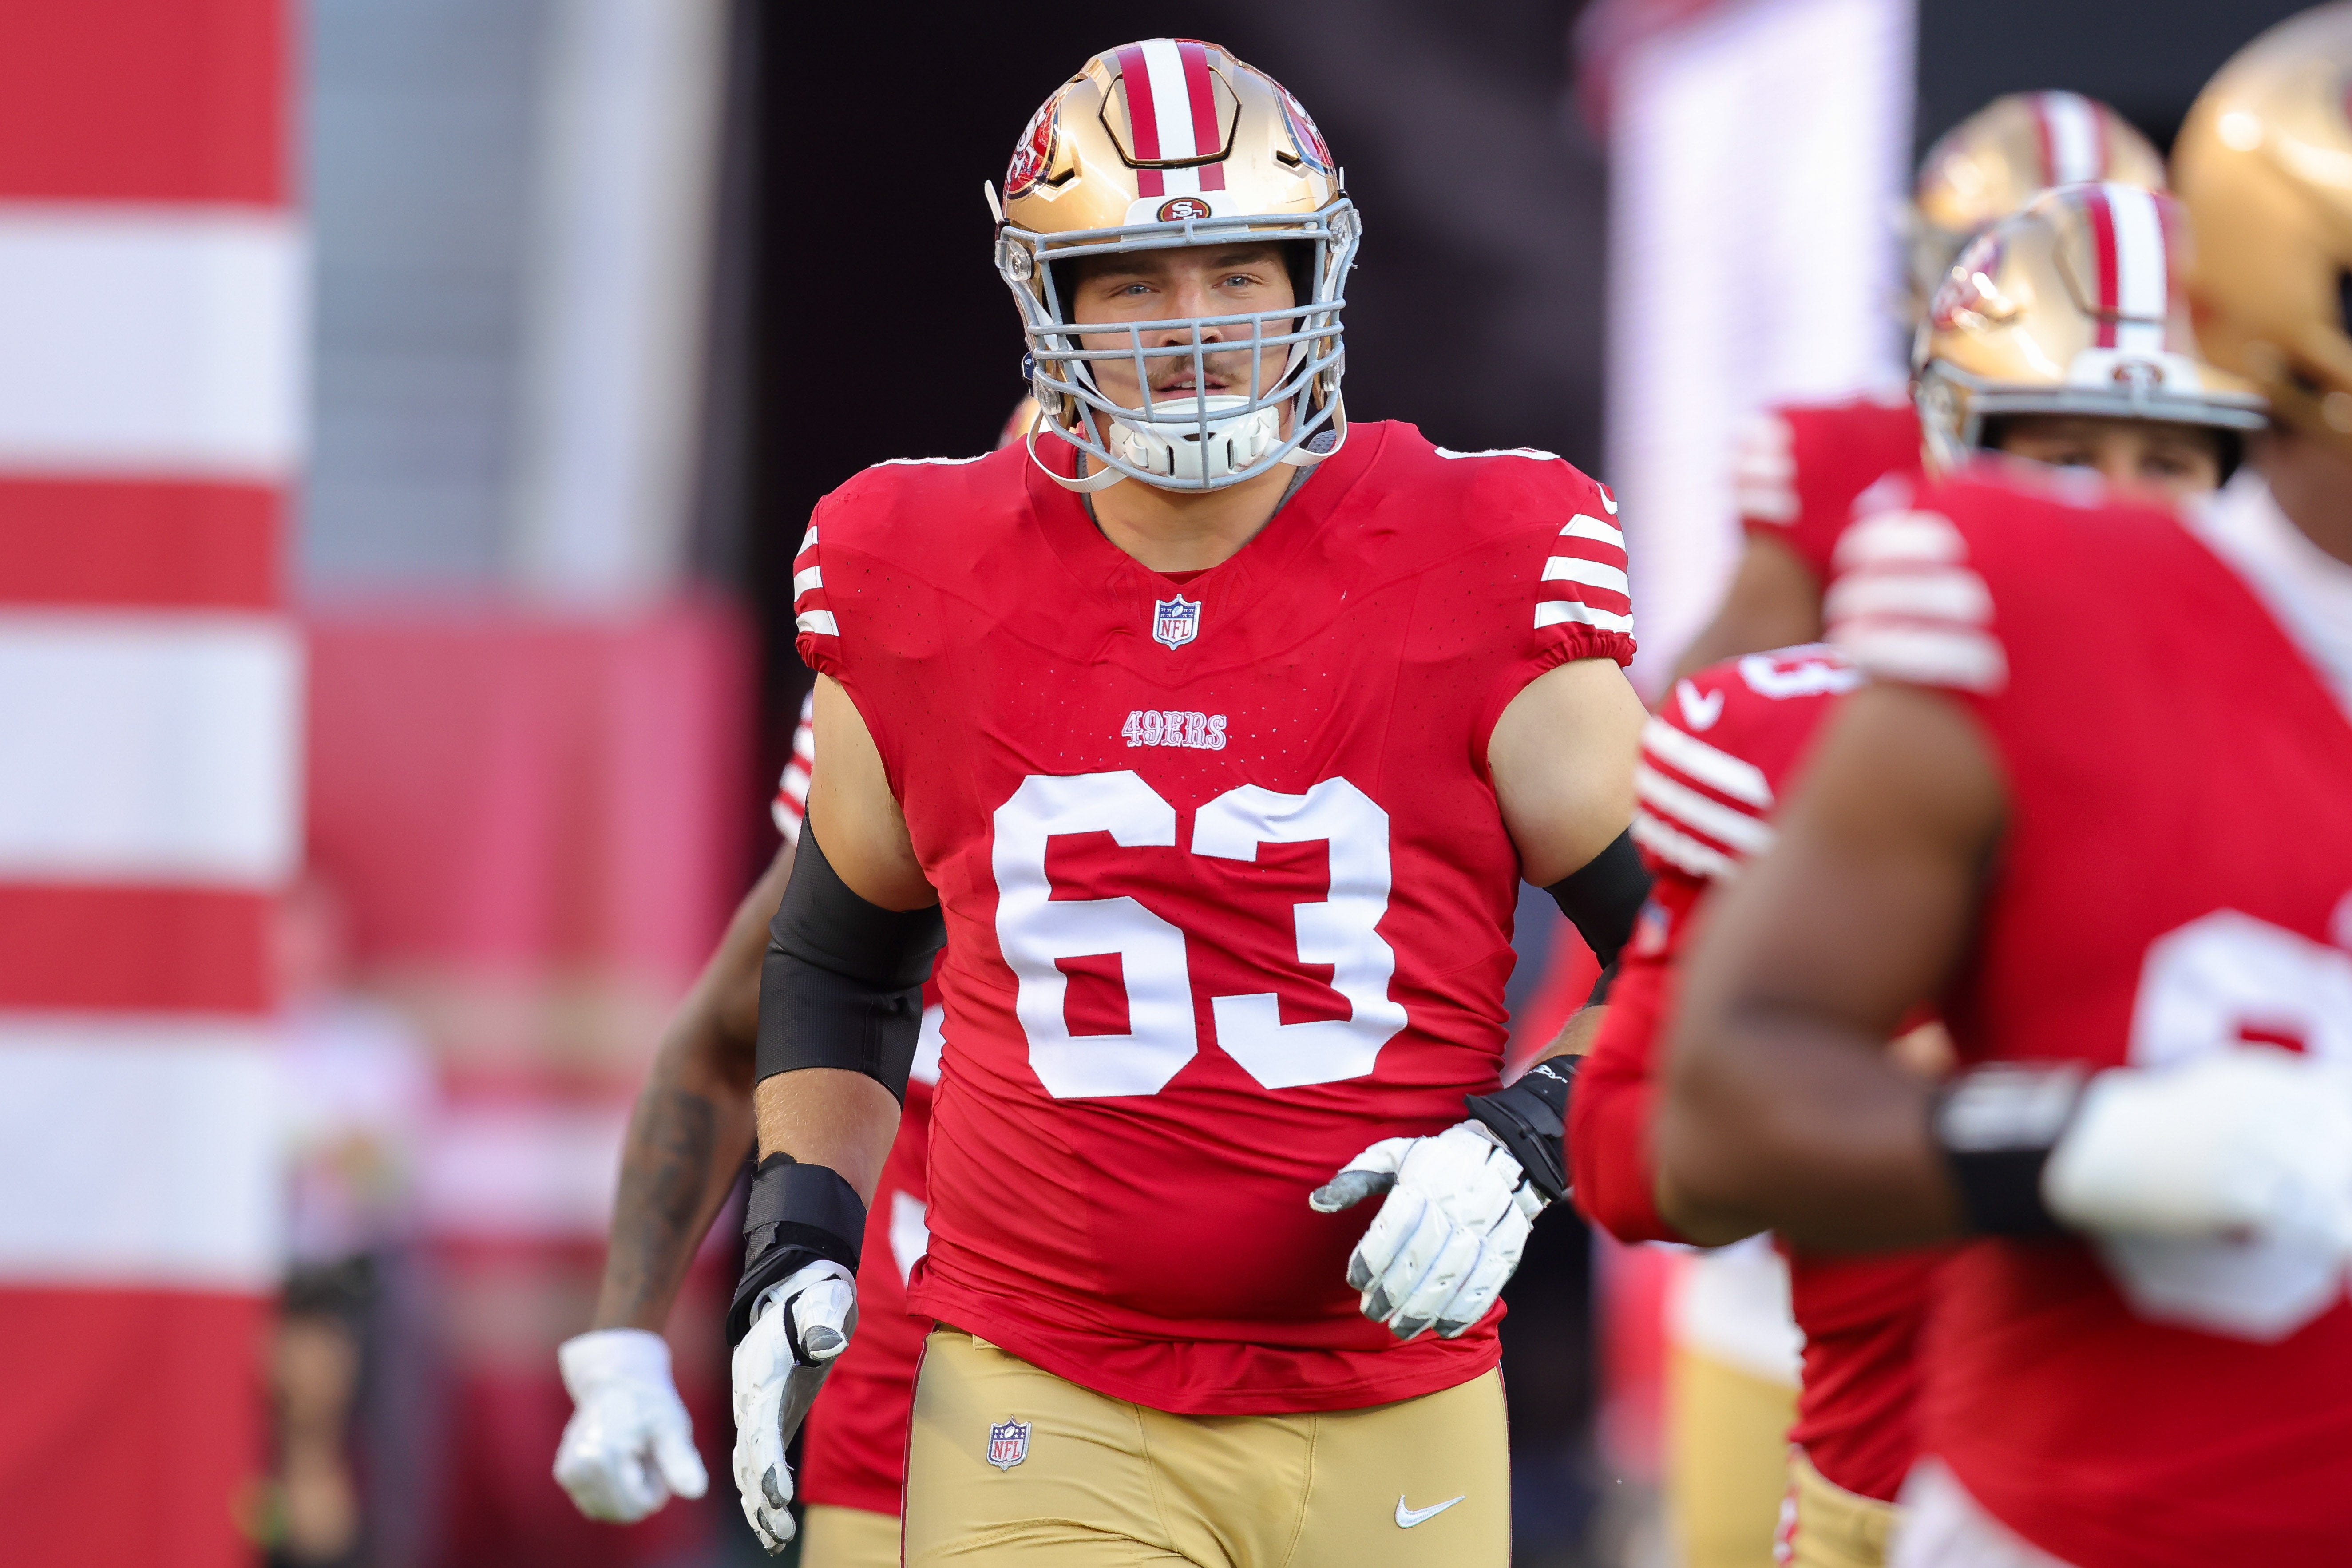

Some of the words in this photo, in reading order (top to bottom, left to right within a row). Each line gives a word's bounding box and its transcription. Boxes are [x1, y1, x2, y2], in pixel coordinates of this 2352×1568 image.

[1160, 620, 1189, 639] NFL
[1121, 710, 1227, 751] 49ERS
[992, 770, 1408, 1098] 63
[992, 1441, 1020, 1459] NFL
